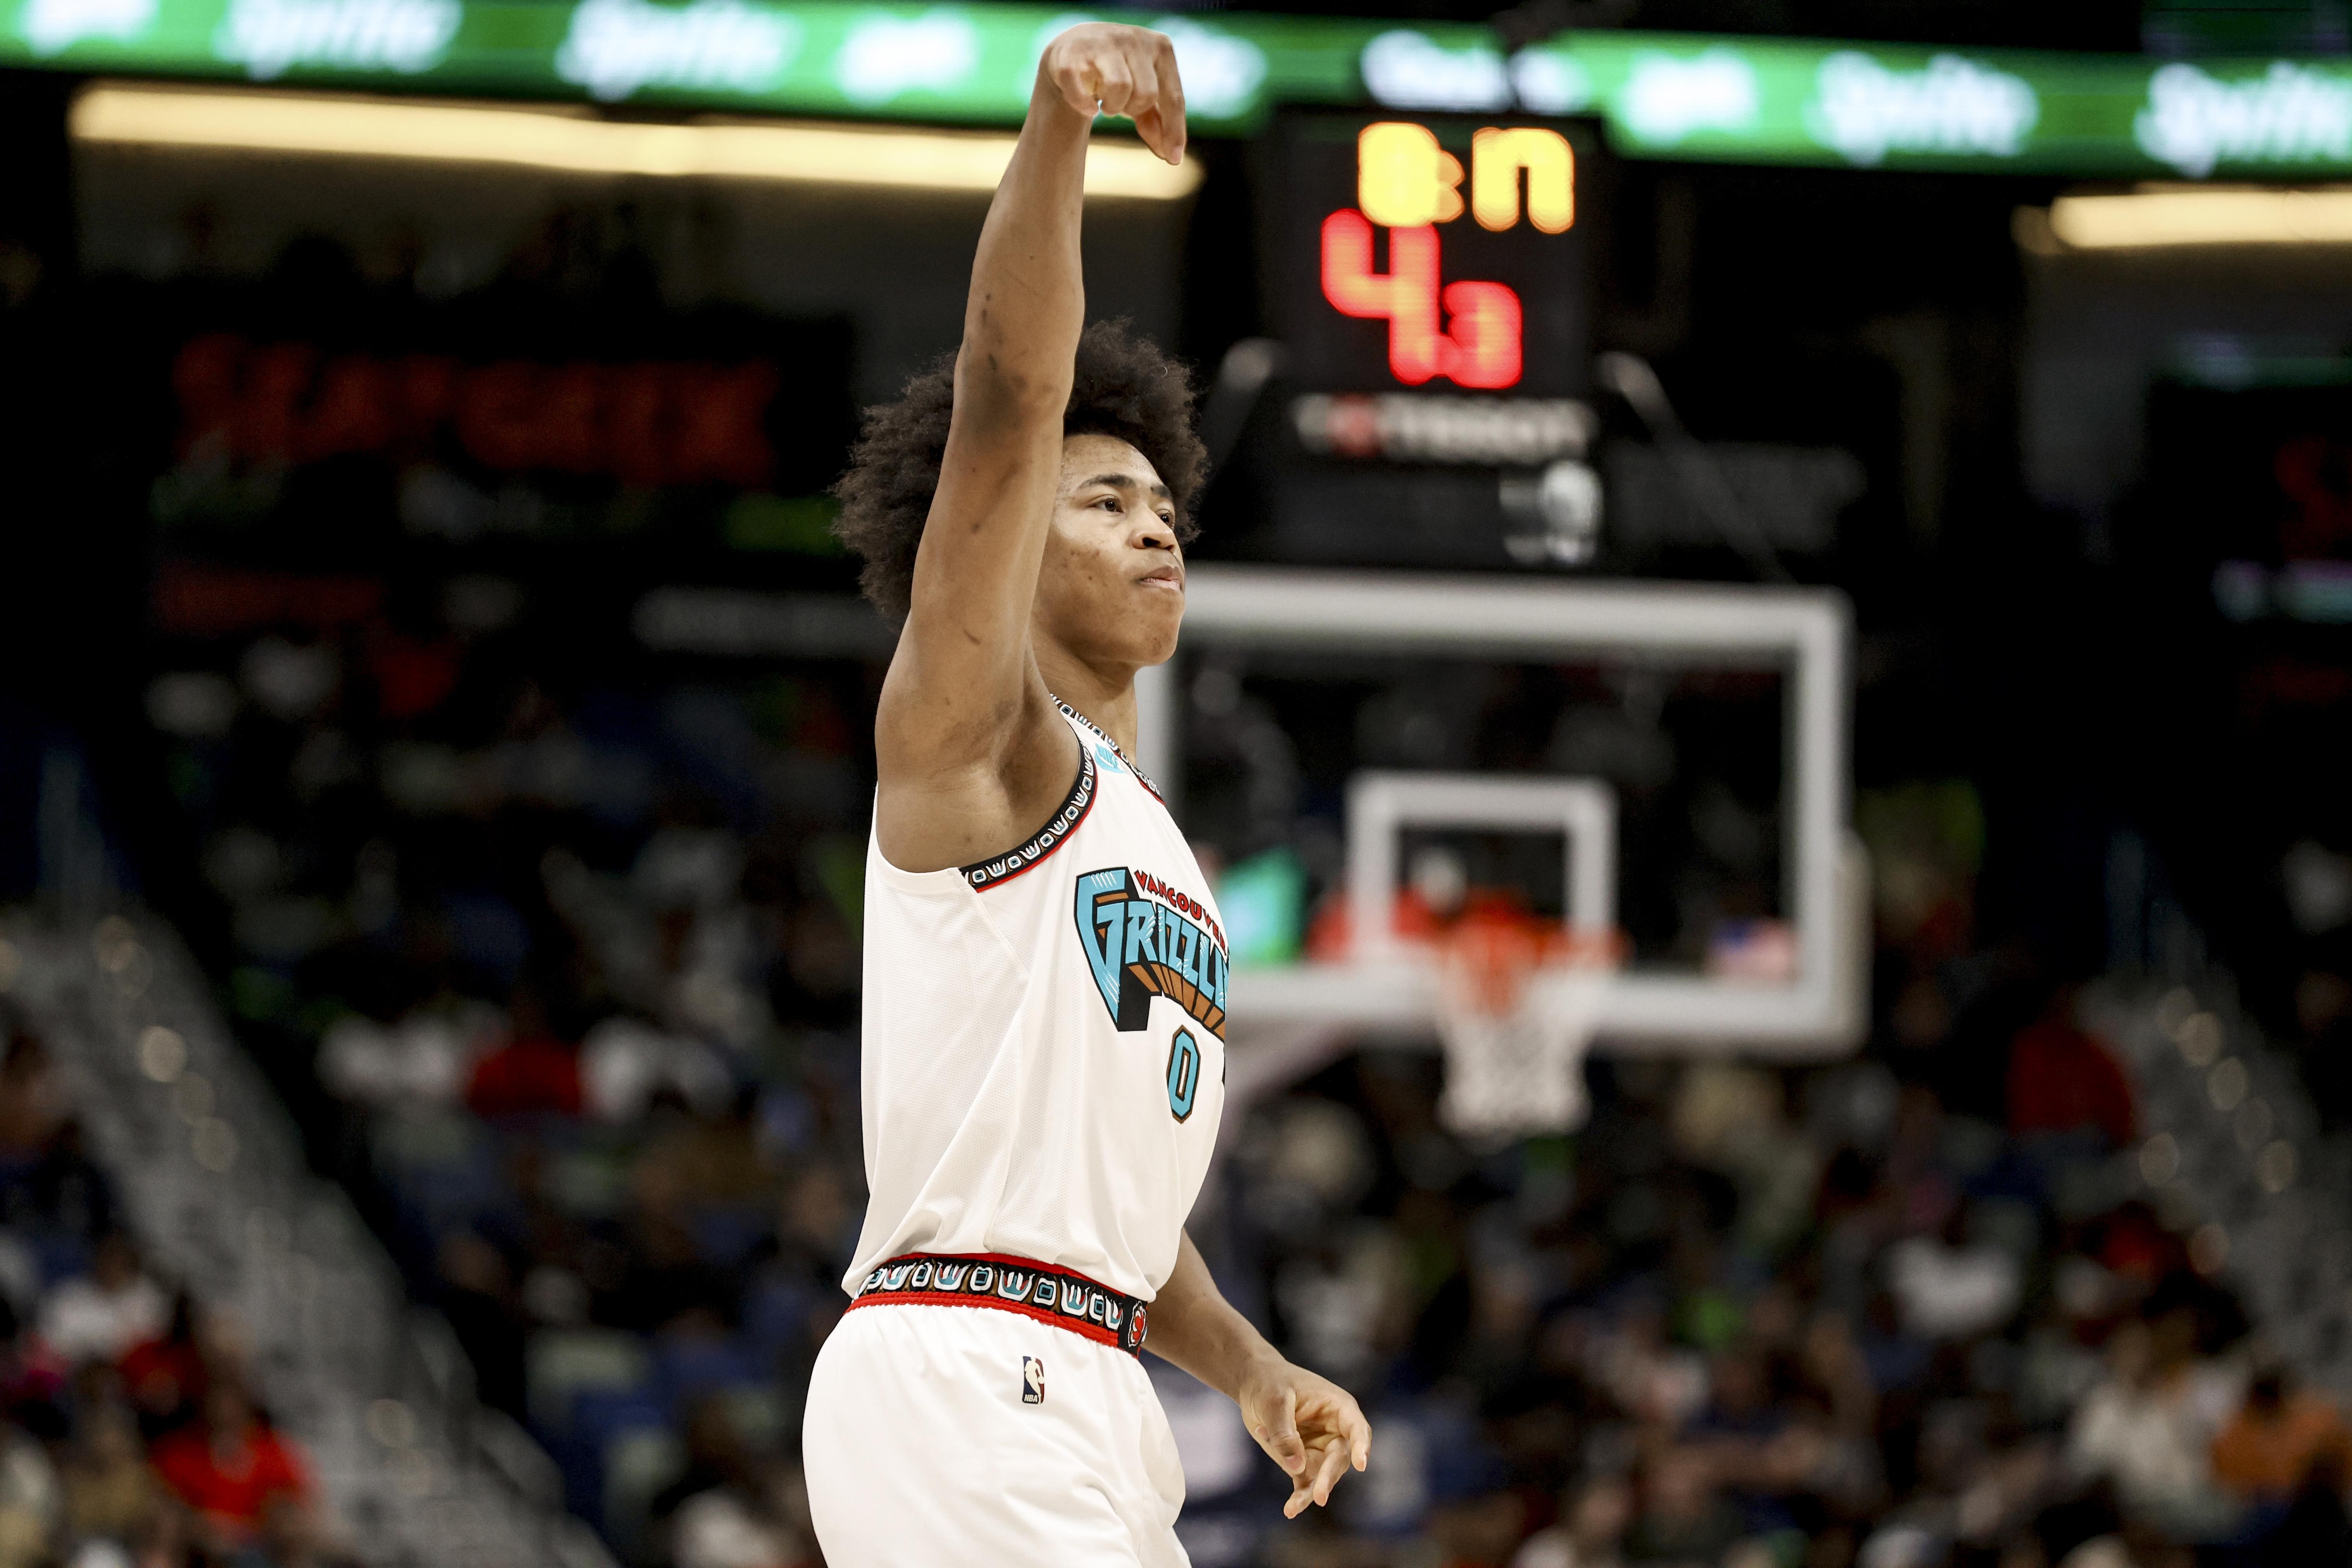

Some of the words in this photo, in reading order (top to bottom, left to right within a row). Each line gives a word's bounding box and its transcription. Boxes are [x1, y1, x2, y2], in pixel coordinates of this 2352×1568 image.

[1074, 867, 1230, 1032] GRIZZLI
[1166, 1025, 1200, 1123] 0
[1024, 1393, 1038, 1402] NBA
